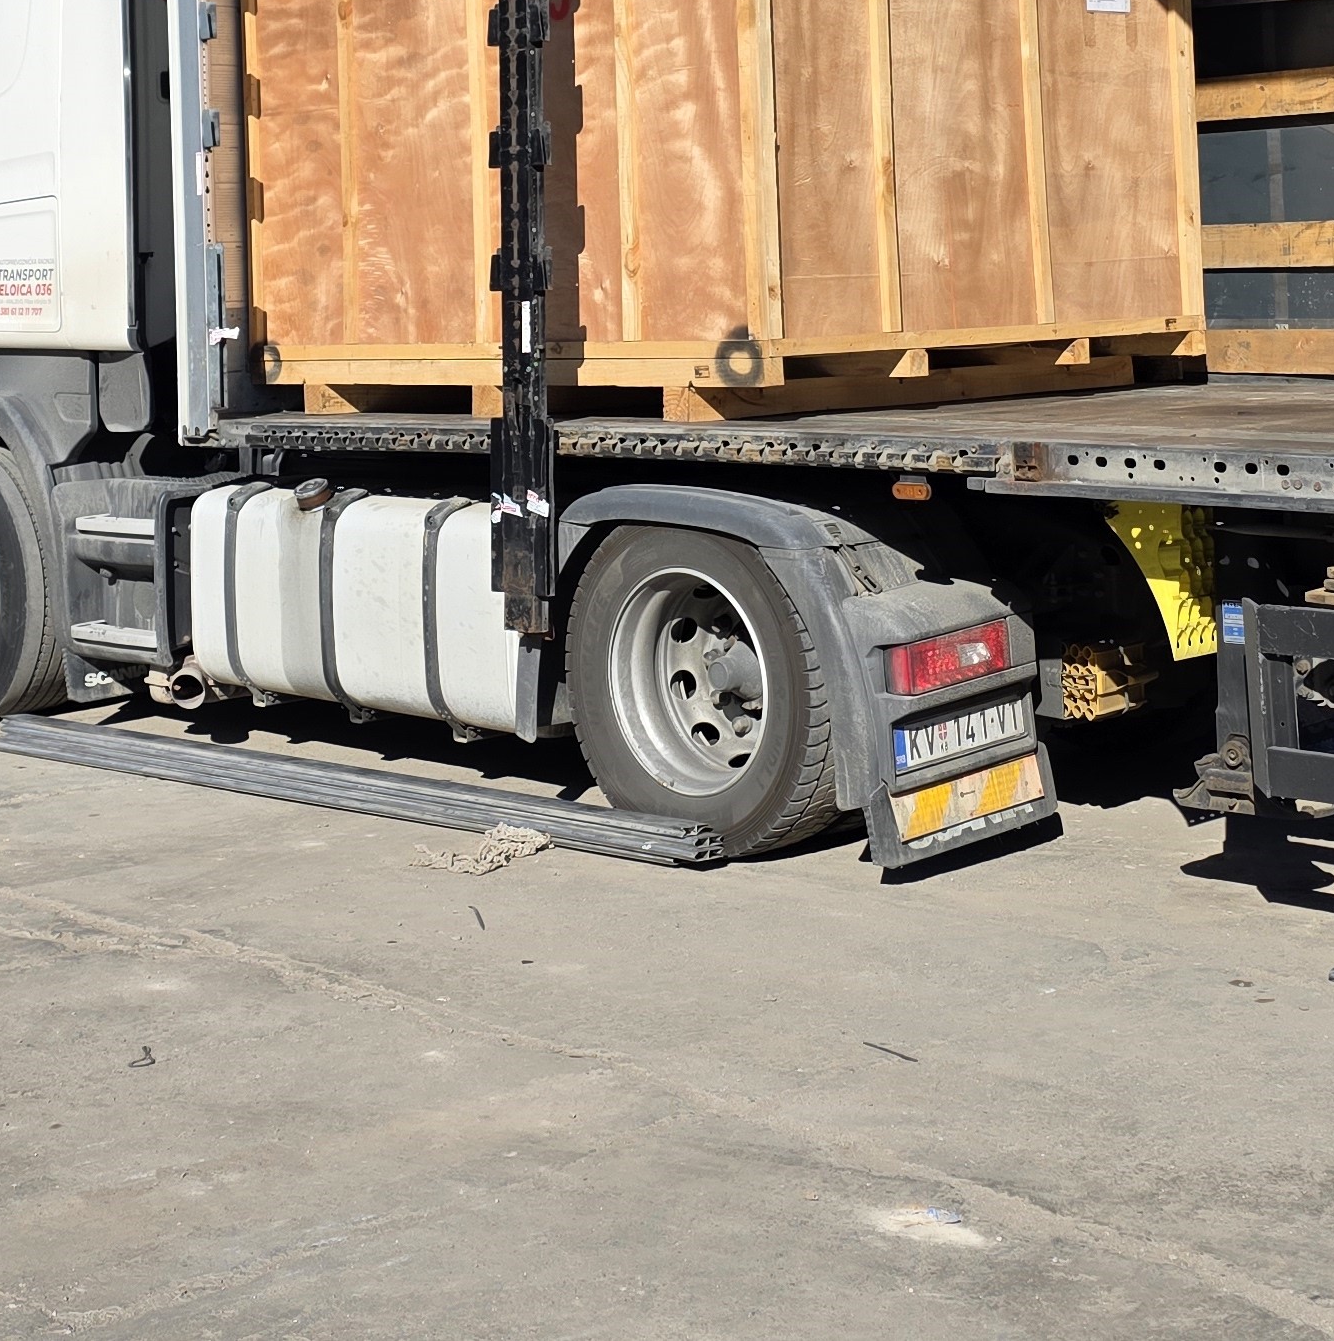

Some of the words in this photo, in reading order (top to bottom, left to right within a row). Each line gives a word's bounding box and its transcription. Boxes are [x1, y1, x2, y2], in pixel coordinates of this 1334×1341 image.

[35, 284, 52, 296] 036
[31, 307, 42, 316] 707
[84, 665, 148, 687] SCANIA
[908, 723, 935, 761] KV
